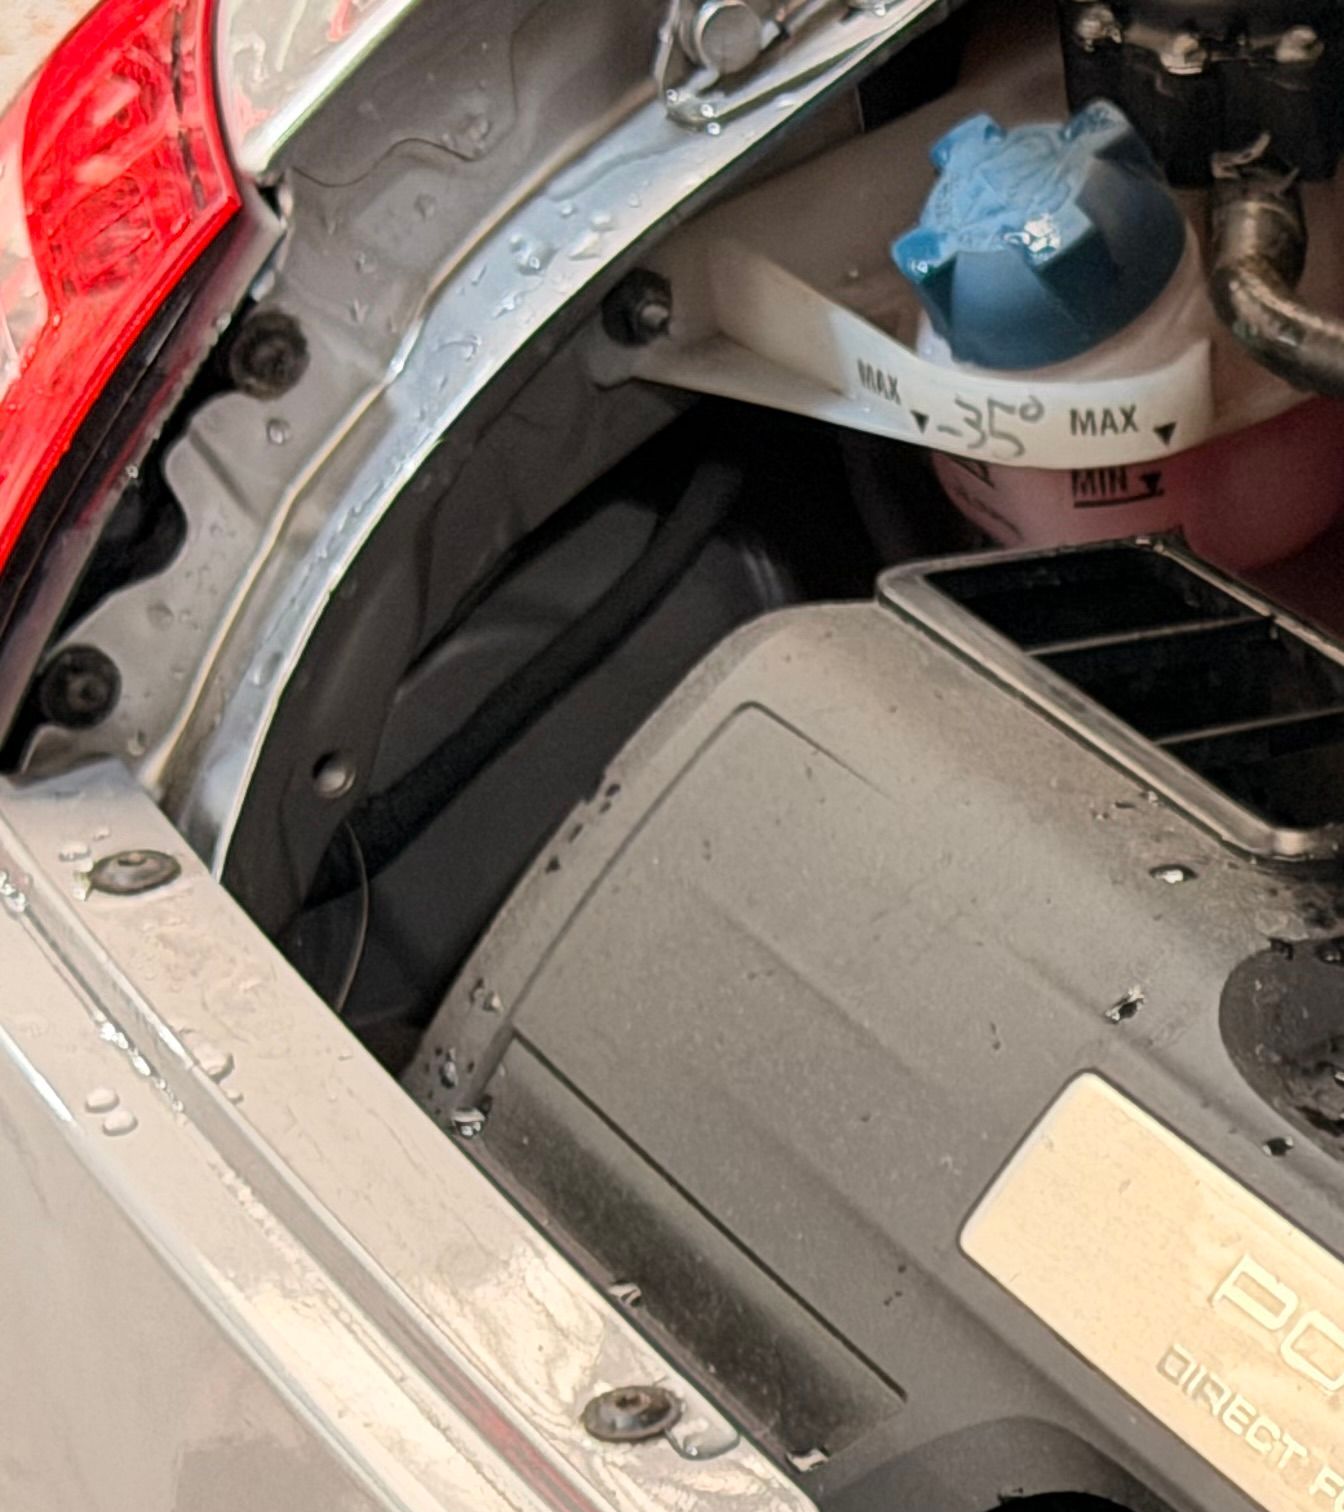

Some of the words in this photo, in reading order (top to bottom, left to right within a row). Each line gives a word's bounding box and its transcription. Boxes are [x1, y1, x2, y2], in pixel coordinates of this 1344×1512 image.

[857, 358, 901, 405] MAX
[1070, 404, 1139, 437] MAX
[1070, 468, 1128, 497] MIN
[1156, 1342, 1309, 1474] DIRECT
